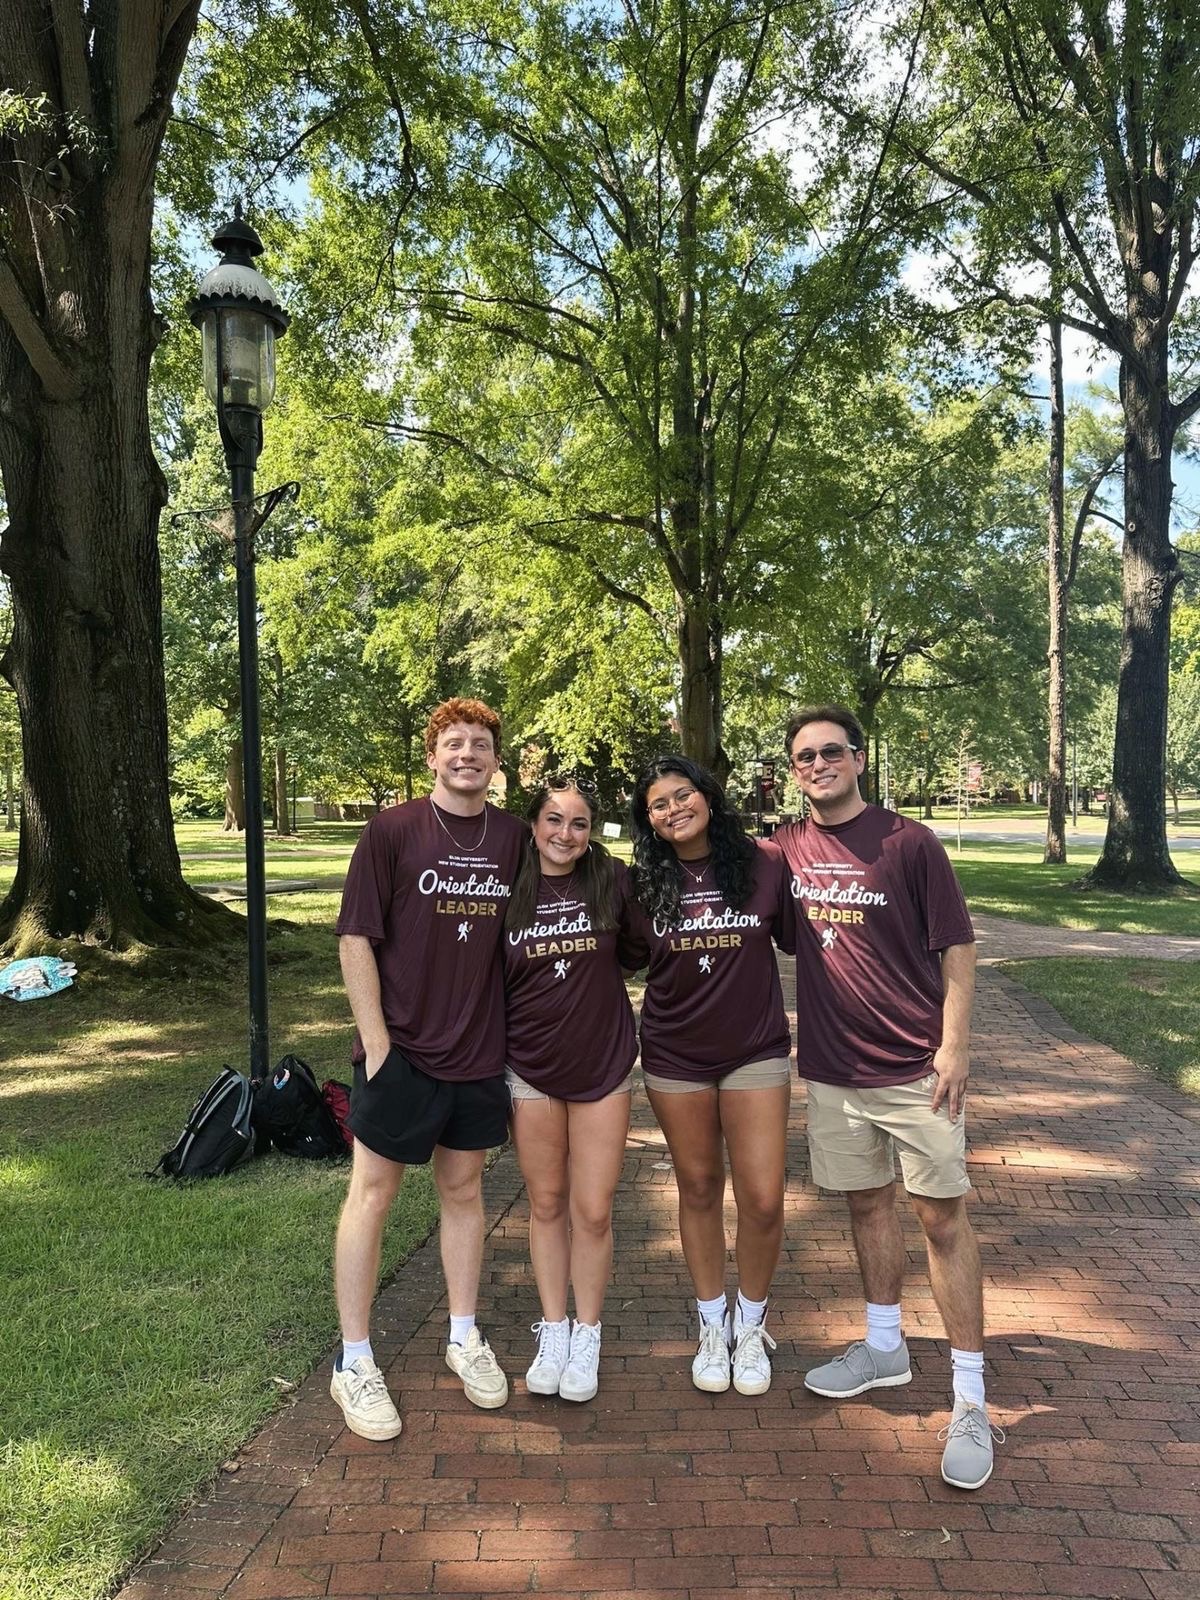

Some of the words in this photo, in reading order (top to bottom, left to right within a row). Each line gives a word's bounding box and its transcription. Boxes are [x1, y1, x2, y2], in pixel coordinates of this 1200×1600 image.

[418, 869, 511, 897] Orientation
[790, 874, 888, 906] Orientation
[436, 900, 497, 916] LEADER
[807, 906, 864, 925] EADER
[525, 937, 598, 959] LEADER
[670, 934, 742, 952] LEADER
